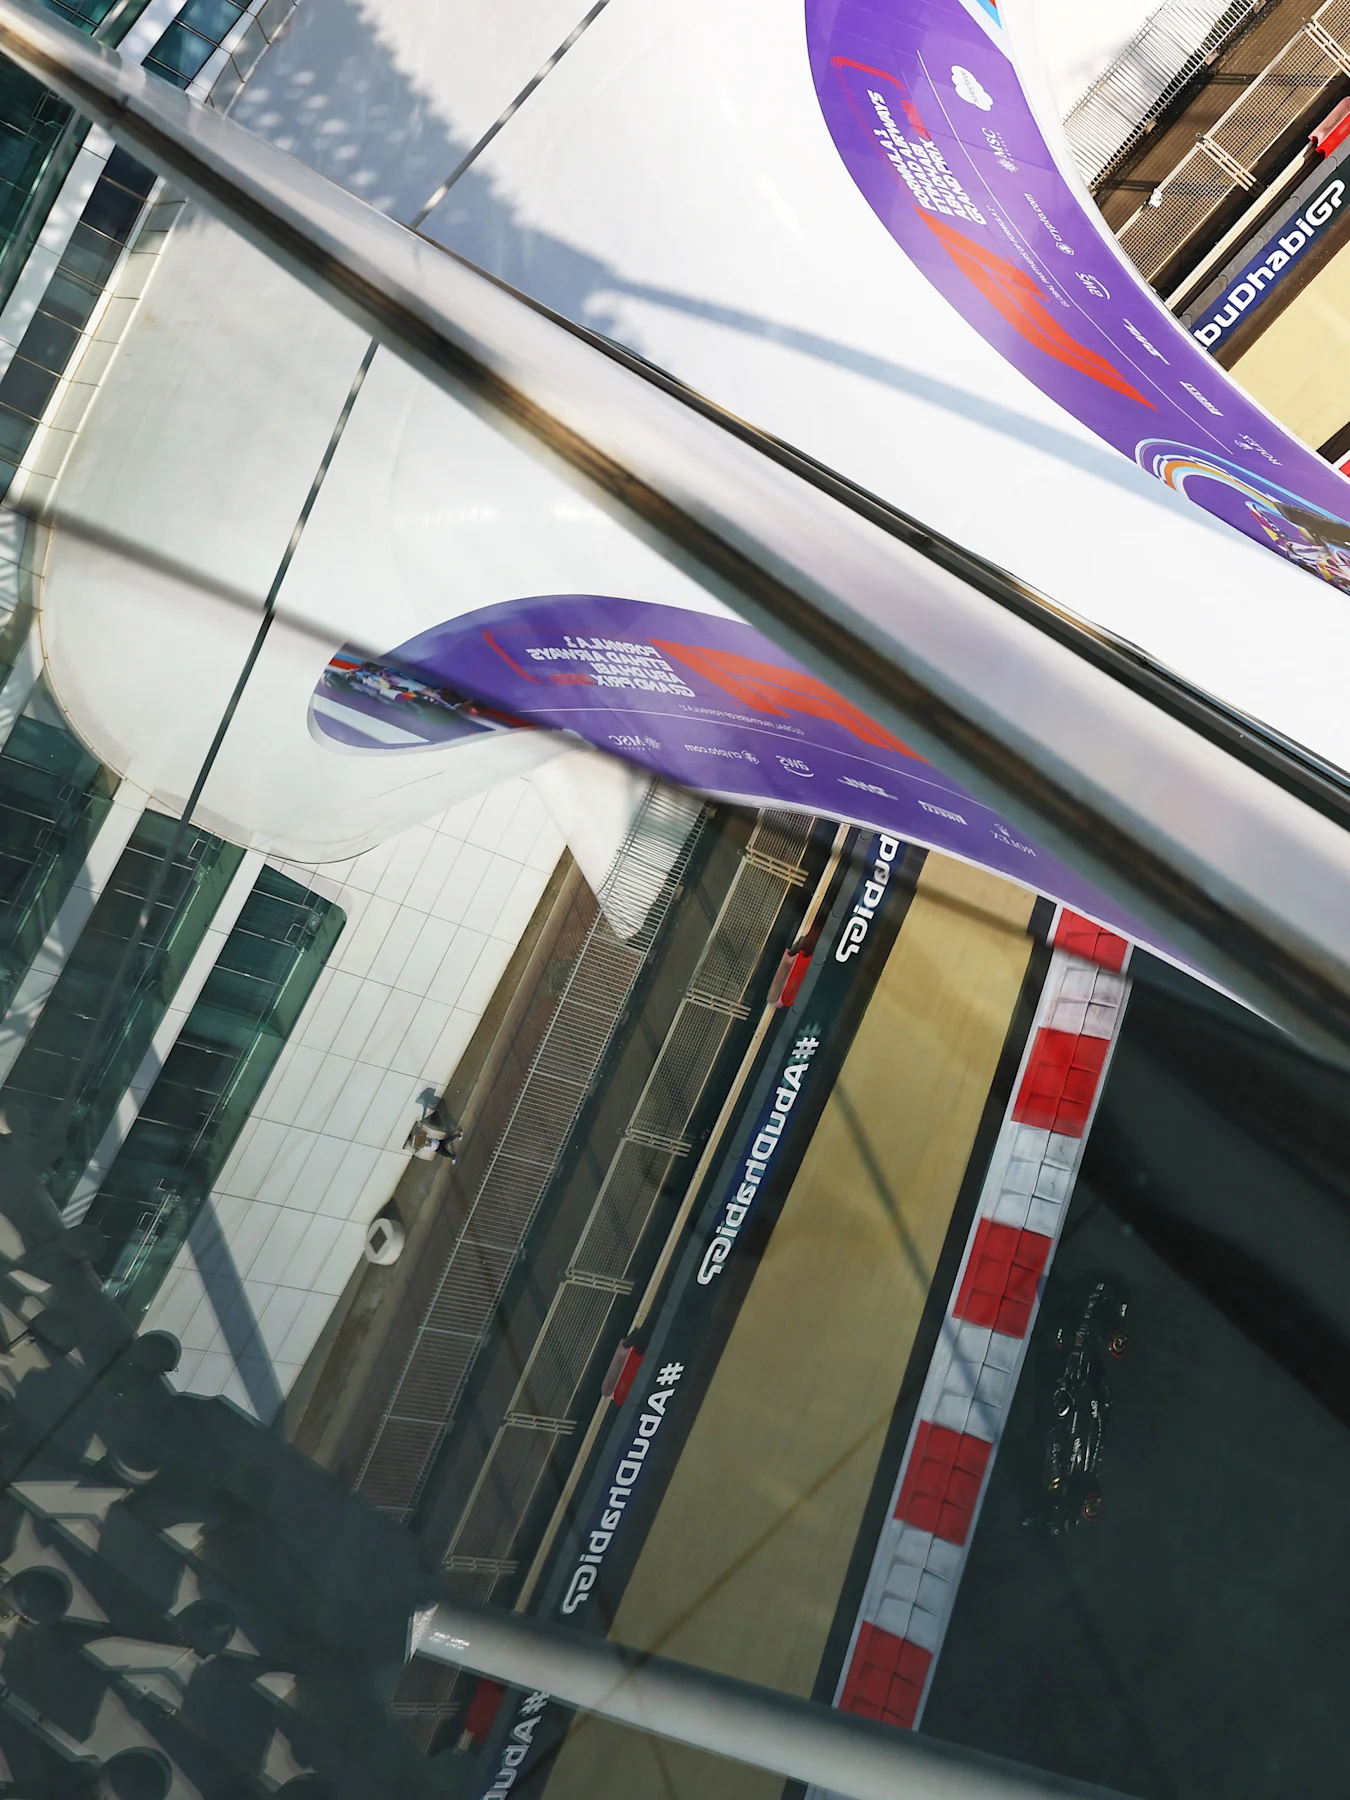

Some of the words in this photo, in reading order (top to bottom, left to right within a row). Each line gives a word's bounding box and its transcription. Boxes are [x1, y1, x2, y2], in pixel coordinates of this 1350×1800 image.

[867, 89, 917, 161] AIRWAYS
[873, 129, 889, 138] 1
[981, 127, 1007, 160] MSC
[880, 140, 938, 212] FORMULA
[908, 142, 950, 190] DHABI
[918, 136, 953, 175] PRIX
[906, 160, 955, 217] ETIHAD
[936, 187, 972, 222] ABU
[942, 174, 987, 225] GRAND
[1194, 179, 1346, 349] buDhabiGP
